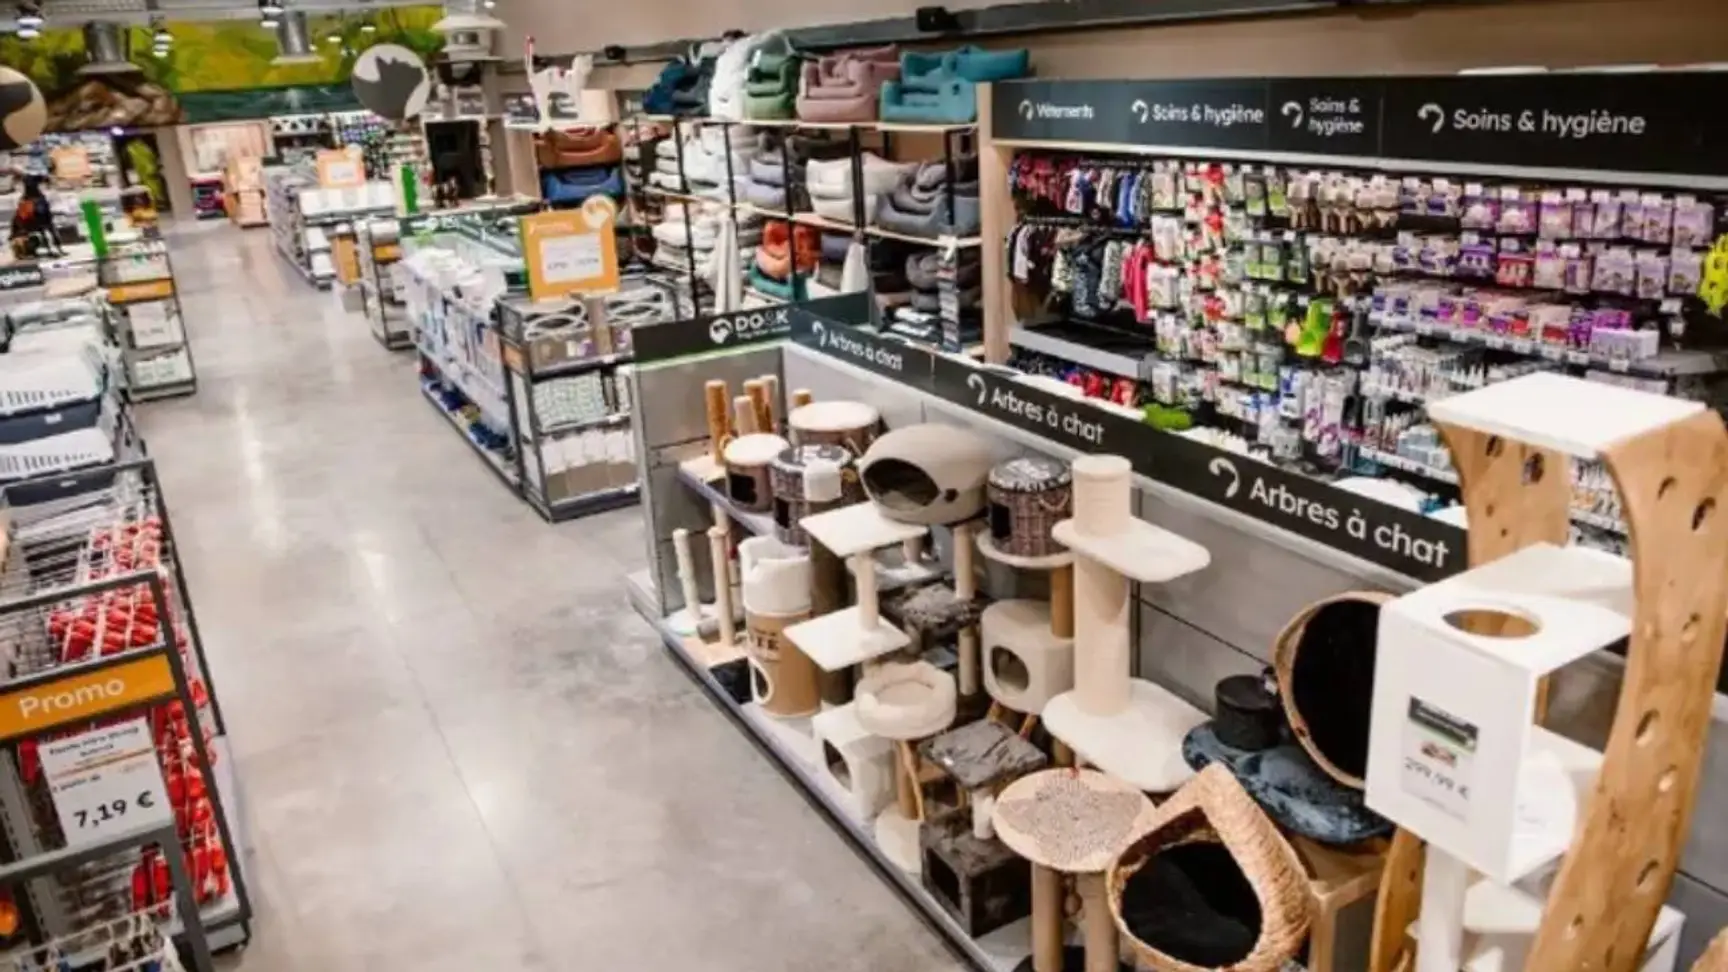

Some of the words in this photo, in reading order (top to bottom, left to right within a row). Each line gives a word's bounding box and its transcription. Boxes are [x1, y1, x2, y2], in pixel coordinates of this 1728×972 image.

[1152, 102, 1188, 121] Soins
[1191, 103, 1201, 121] &
[1203, 102, 1264, 127] hygiène
[1309, 96, 1345, 113] Soins
[1348, 97, 1360, 113] &
[1453, 107, 1512, 131] Soins
[1517, 108, 1535, 132] &
[1542, 109, 1646, 138] hygiène
[1308, 116, 1364, 136] hygiène
[828, 329, 864, 357] Arbres
[875, 347, 903, 371] chat
[991, 386, 1043, 423] Arbres
[1046, 406, 1058, 428] à
[1062, 412, 1104, 444] chat
[1250, 477, 1340, 530] Arbres
[1346, 509, 1366, 540] à
[1374, 523, 1449, 568] chat
[19, 678, 125, 720] Promo
[73, 799, 127, 828] 7,19
[136, 790, 155, 808] €
